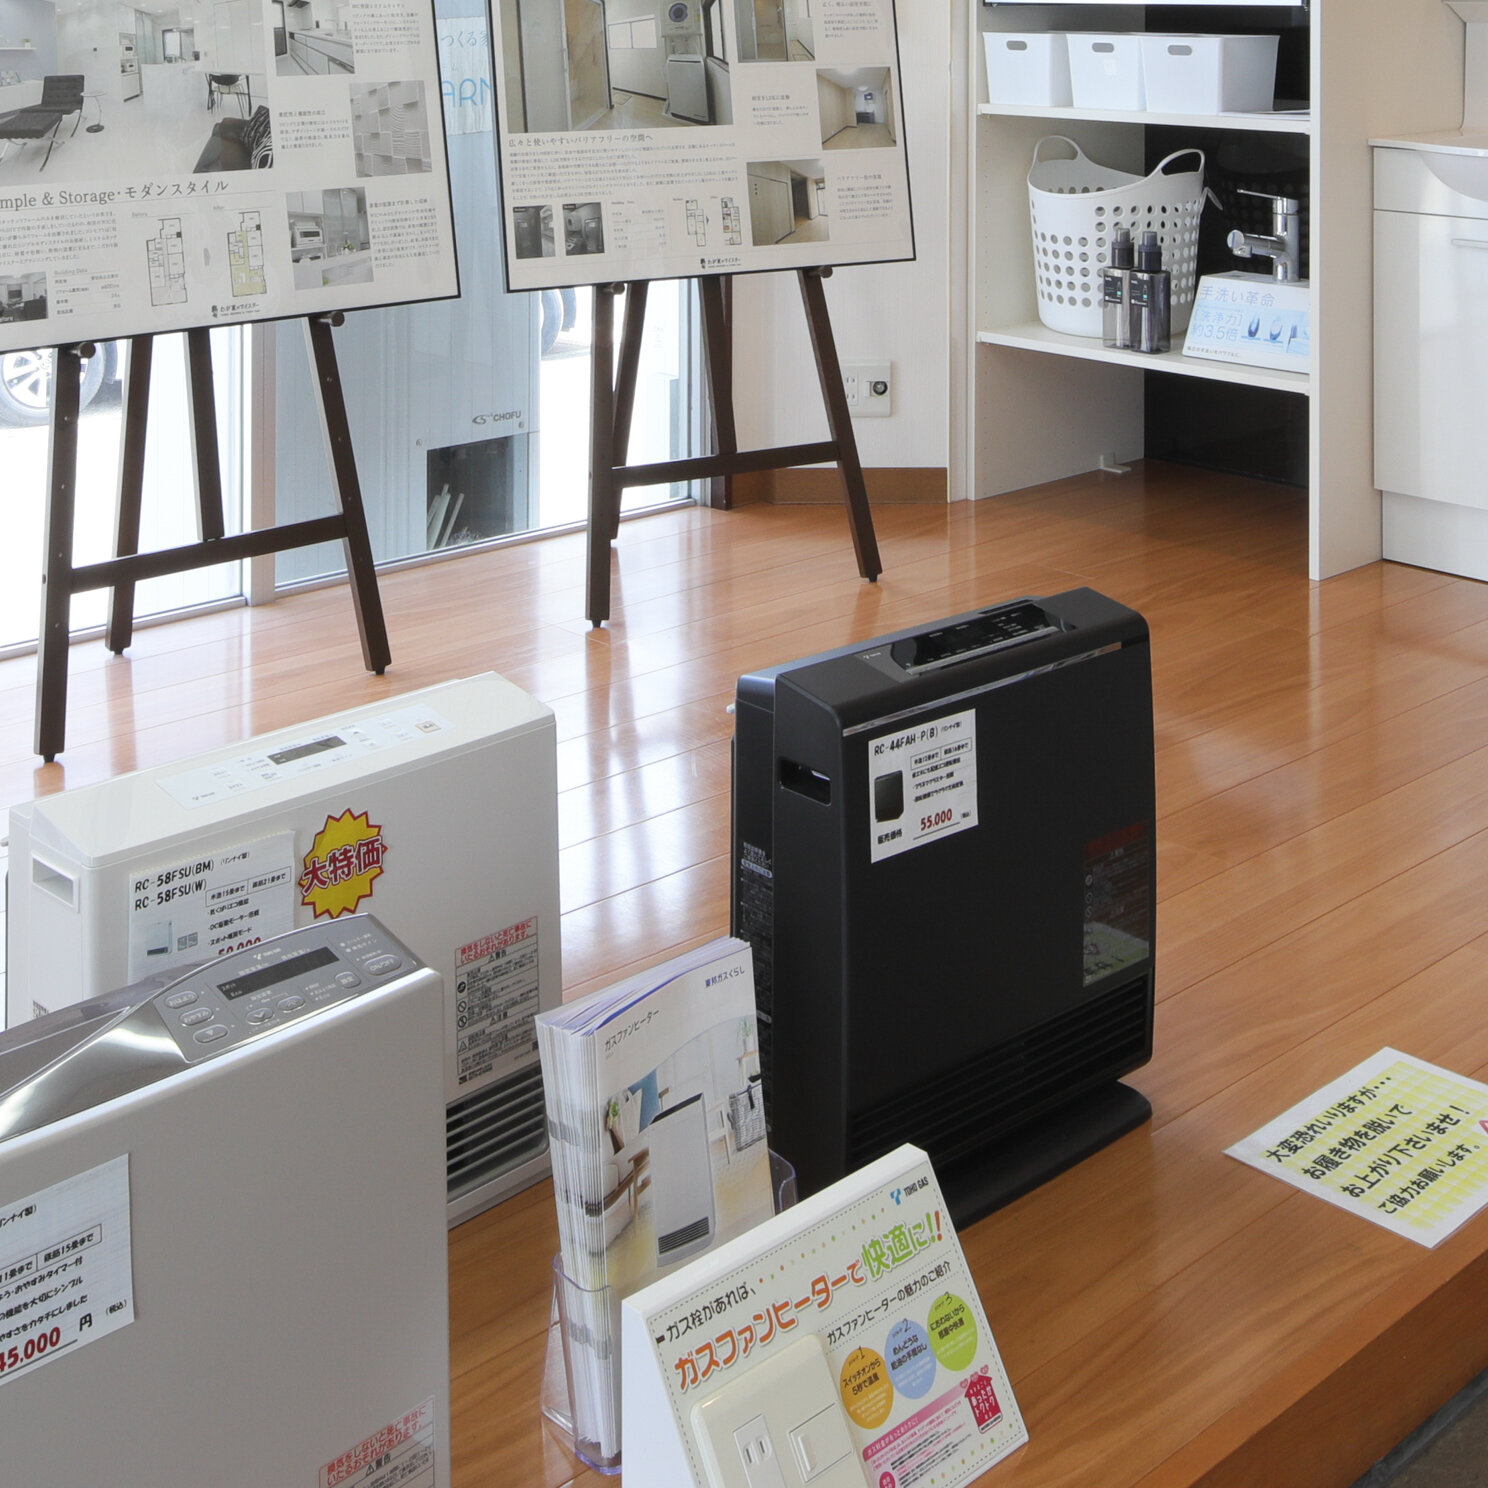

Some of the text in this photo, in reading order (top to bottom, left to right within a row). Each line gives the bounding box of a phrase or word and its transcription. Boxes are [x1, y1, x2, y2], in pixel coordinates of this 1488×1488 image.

[42, 191, 55, 206] &
[1200, 285, 1275, 307] 手洗い革命
[493, 411, 522, 422] CHOFU
[135, 859, 214, 893] RC-58FSU(BM)
[302, 834, 384, 895] 大特価
[135, 878, 207, 911] RC-58FSU(W)
[705, 965, 745, 989] 東邦ガスくらし
[605, 1009, 660, 1052] ガスファンヒーター
[1302, 1103, 1413, 1181] お履き物を脱いで
[1340, 1104, 1471, 1199] お上がり下さいませ！
[1378, 1143, 1480, 1214] ご協力お願いします。
[666, 1280, 758, 1343] ガス栓があれば、
[673, 1209, 944, 1392] ガスファンヒーターで快適に!!
[826, 1260, 952, 1346] ガスファンヒーターの魅力のご紹介
[79, 1312, 93, 1333] 円
[893, 1334, 919, 1356] めんどうな
[841, 1357, 882, 1389] スイッチオンから
